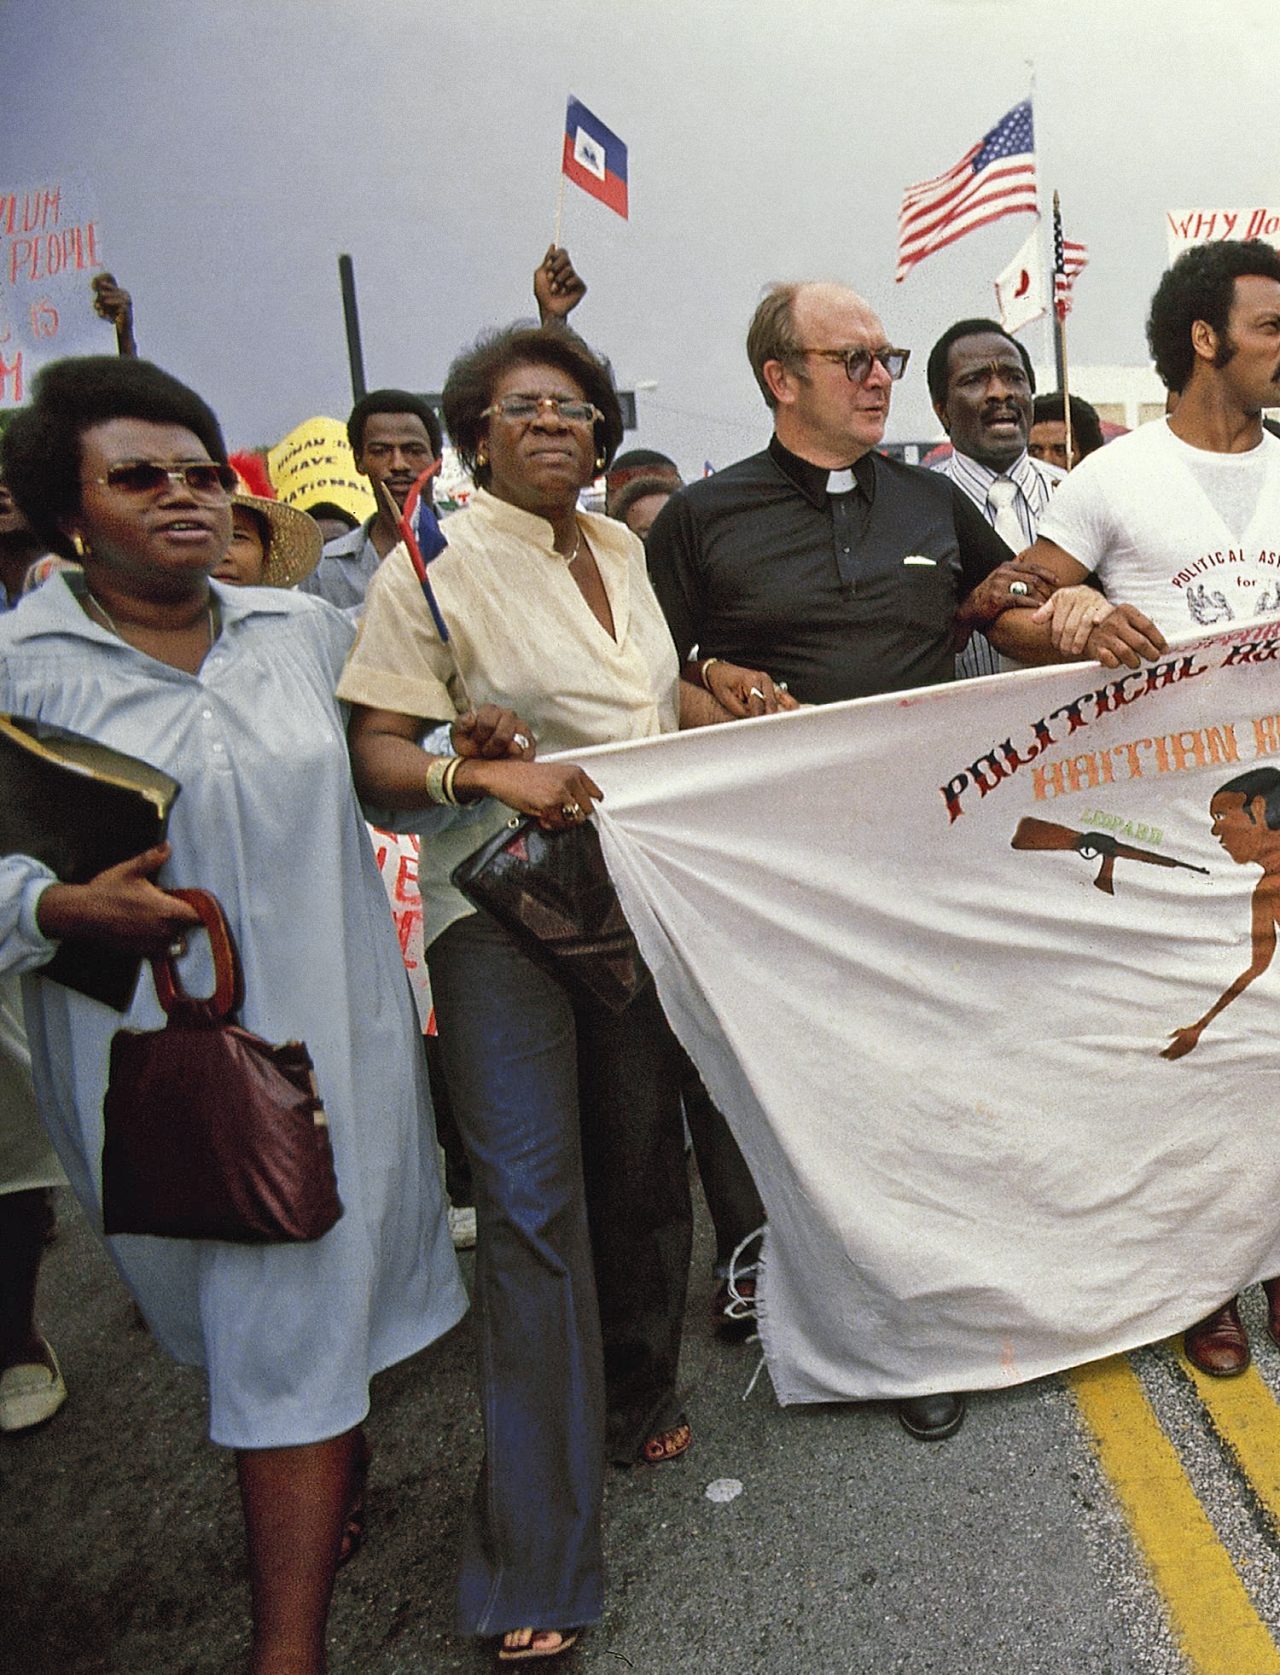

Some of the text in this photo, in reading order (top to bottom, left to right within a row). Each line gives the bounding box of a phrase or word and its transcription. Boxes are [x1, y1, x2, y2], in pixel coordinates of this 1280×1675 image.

[1167, 213, 1238, 240] WHY
[10, 223, 104, 285] PEOPLE
[1172, 549, 1245, 589] POLITICAL
[1236, 576, 1257, 587] for
[939, 654, 1208, 825] POLITICAL
[1031, 722, 1241, 801] HAITIAN
